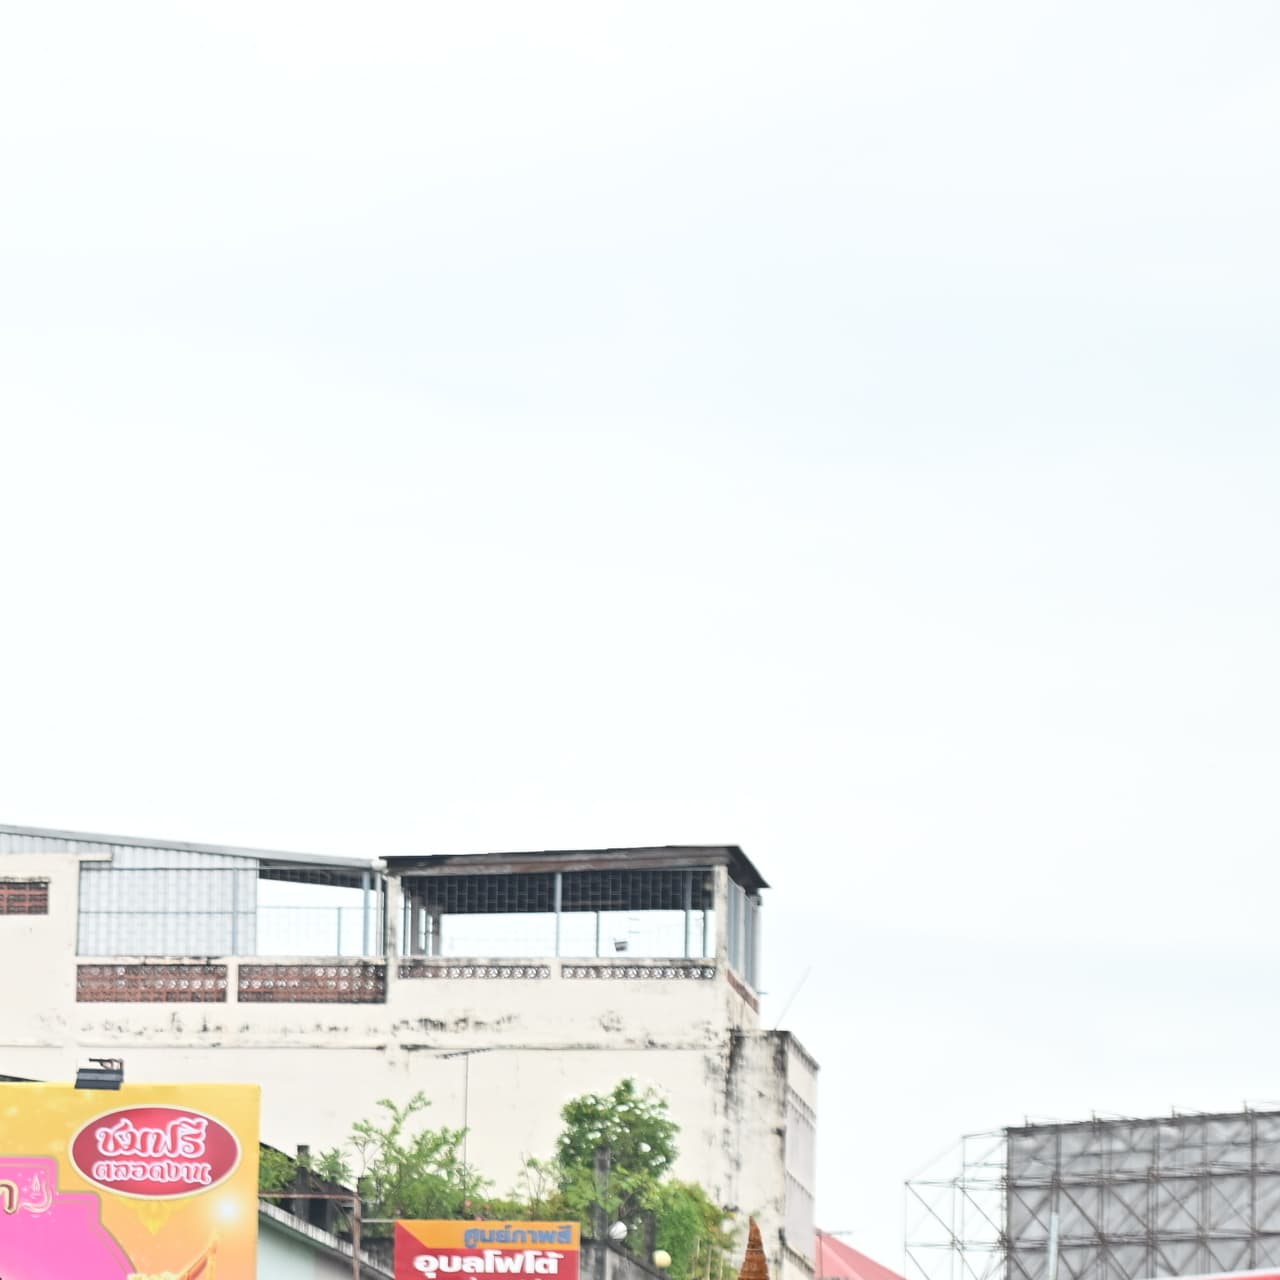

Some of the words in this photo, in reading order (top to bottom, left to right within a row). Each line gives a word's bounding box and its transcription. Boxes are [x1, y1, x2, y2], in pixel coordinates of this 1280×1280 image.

[95, 1117, 209, 1157] ชมฟรี
[92, 1160, 212, 1185] ตลอดงาน
[463, 1225, 573, 1248] ศูนย์ภาพสี
[413, 1249, 565, 1279] อุบลโฟโต้
